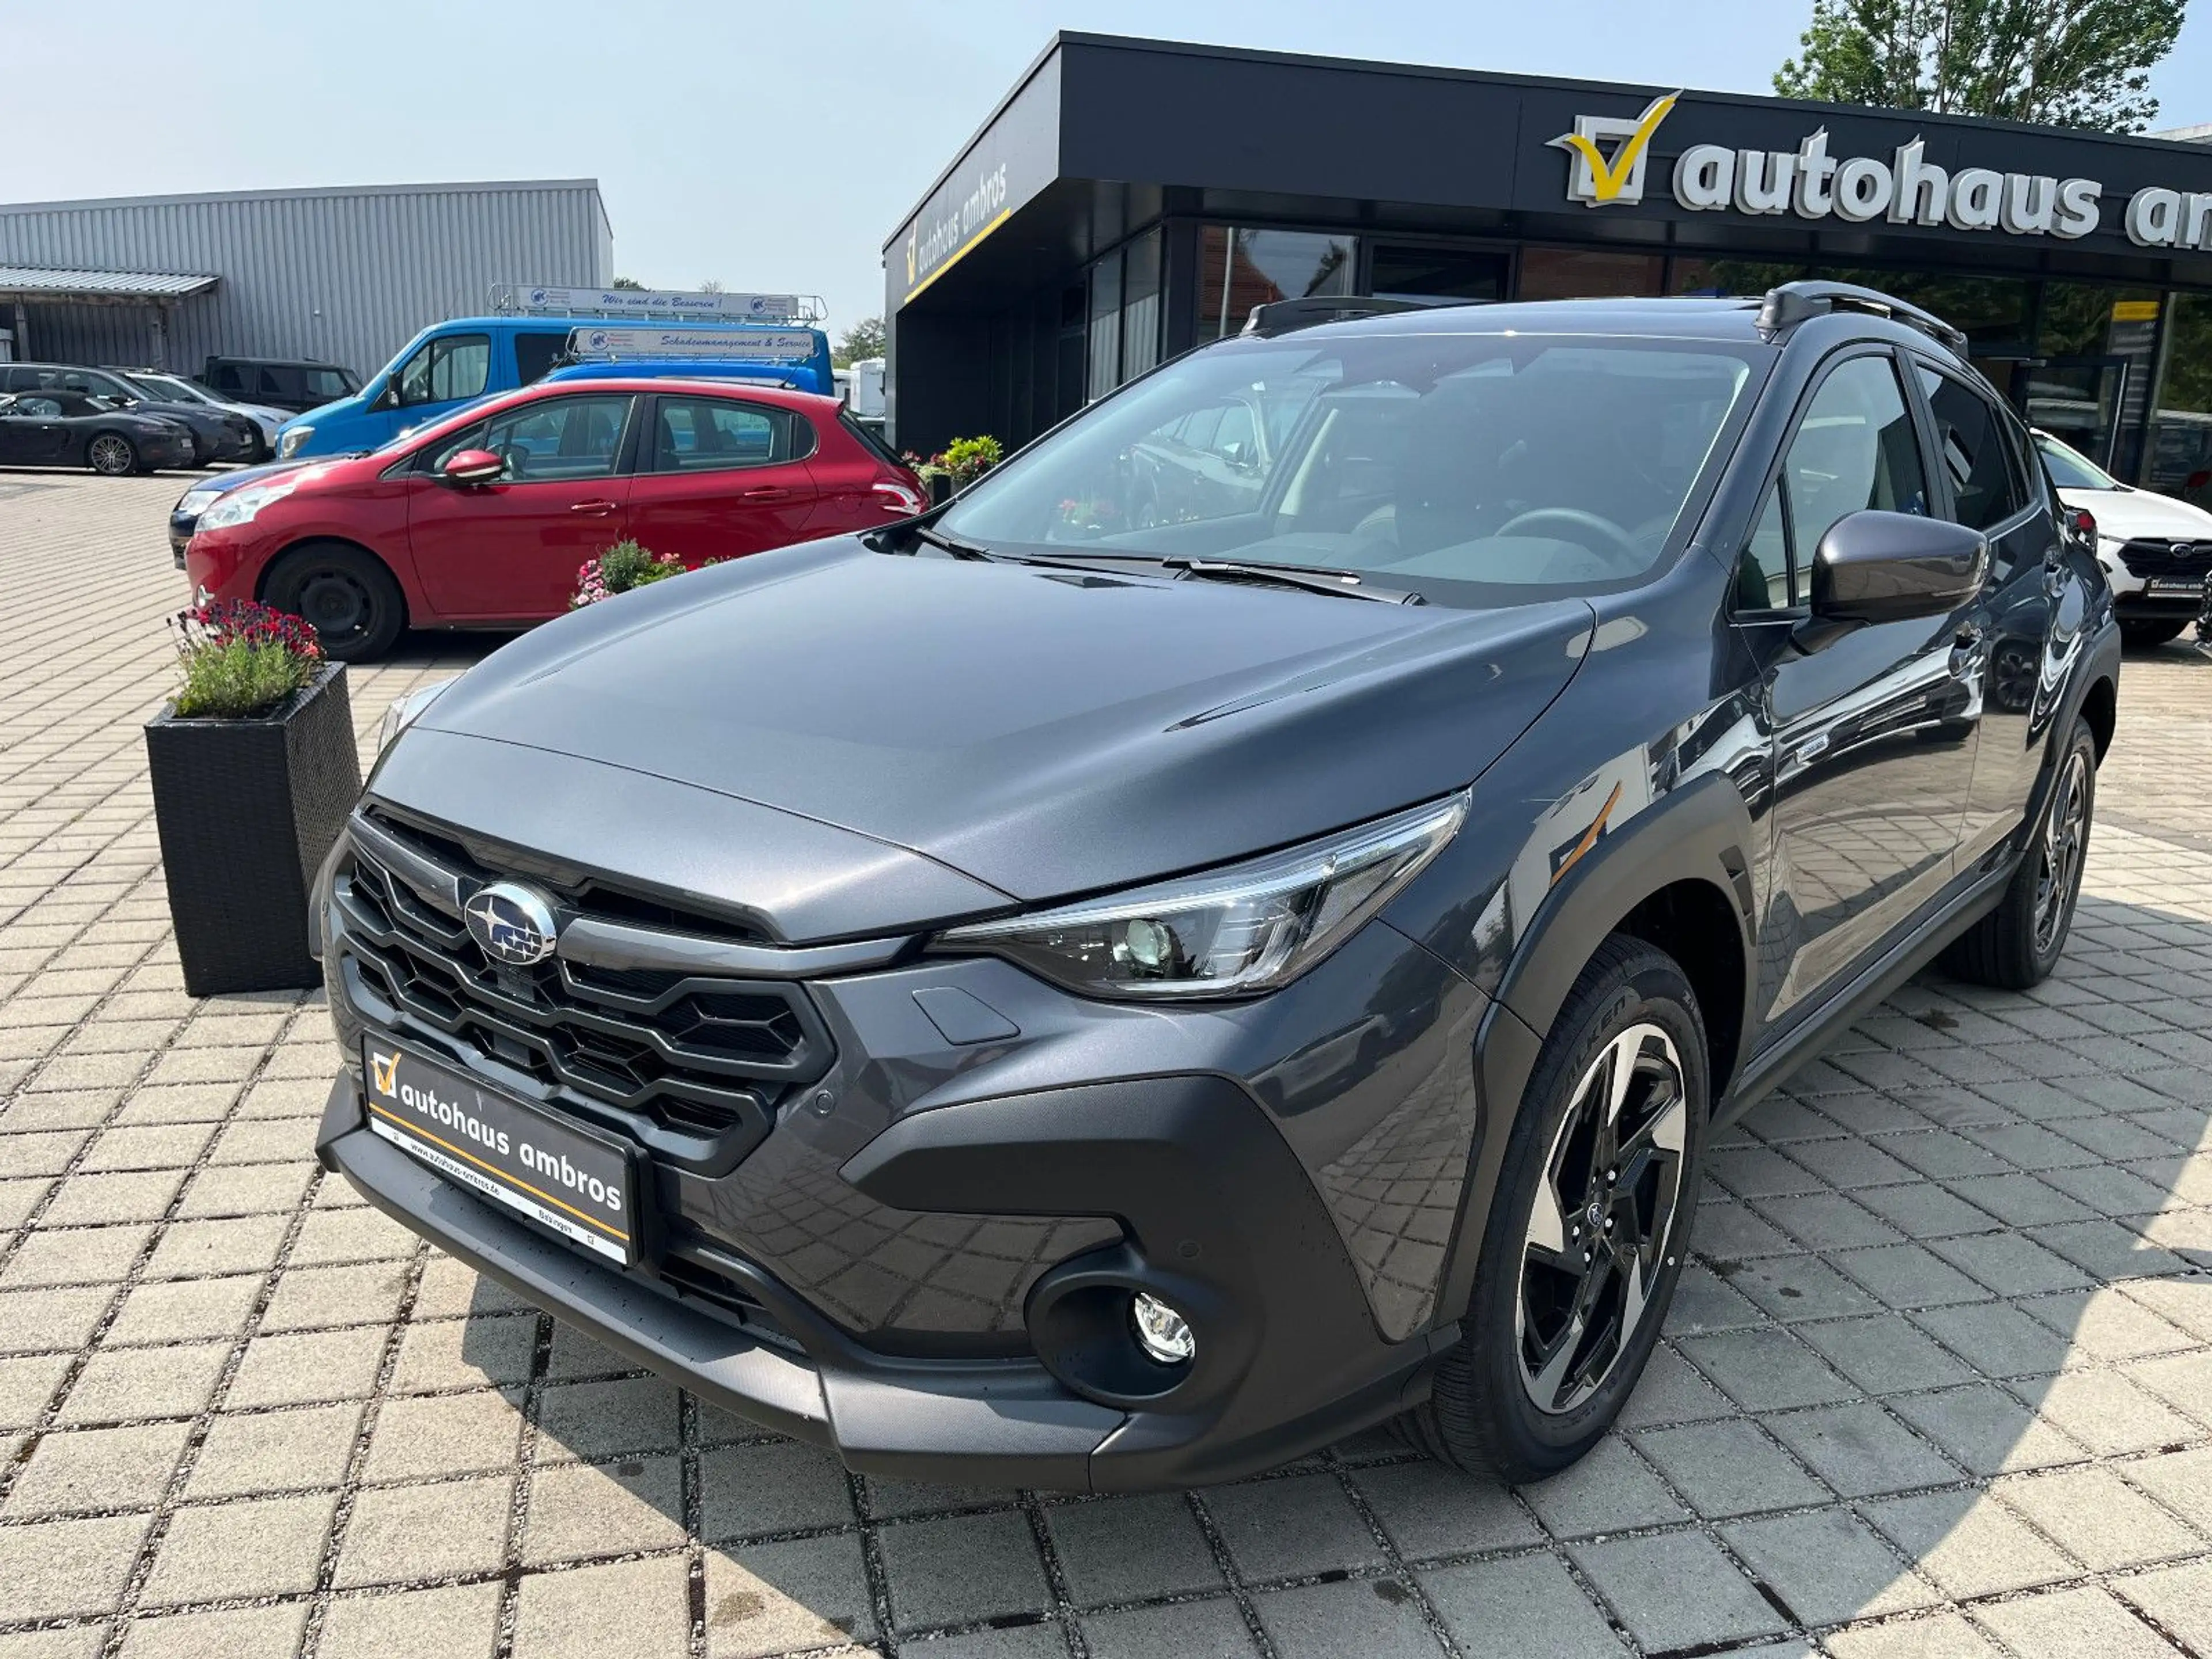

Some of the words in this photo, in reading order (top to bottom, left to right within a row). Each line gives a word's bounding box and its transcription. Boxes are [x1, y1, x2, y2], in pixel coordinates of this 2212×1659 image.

[919, 211, 959, 275] autohaus
[963, 163, 1006, 235] ambros
[1673, 126, 2103, 238] autohaus
[602, 294, 623, 304] Wir
[626, 297, 649, 305] sind
[652, 297, 668, 306] die
[401, 1083, 510, 1156] autohaus
[520, 1142, 622, 1211] ambros
